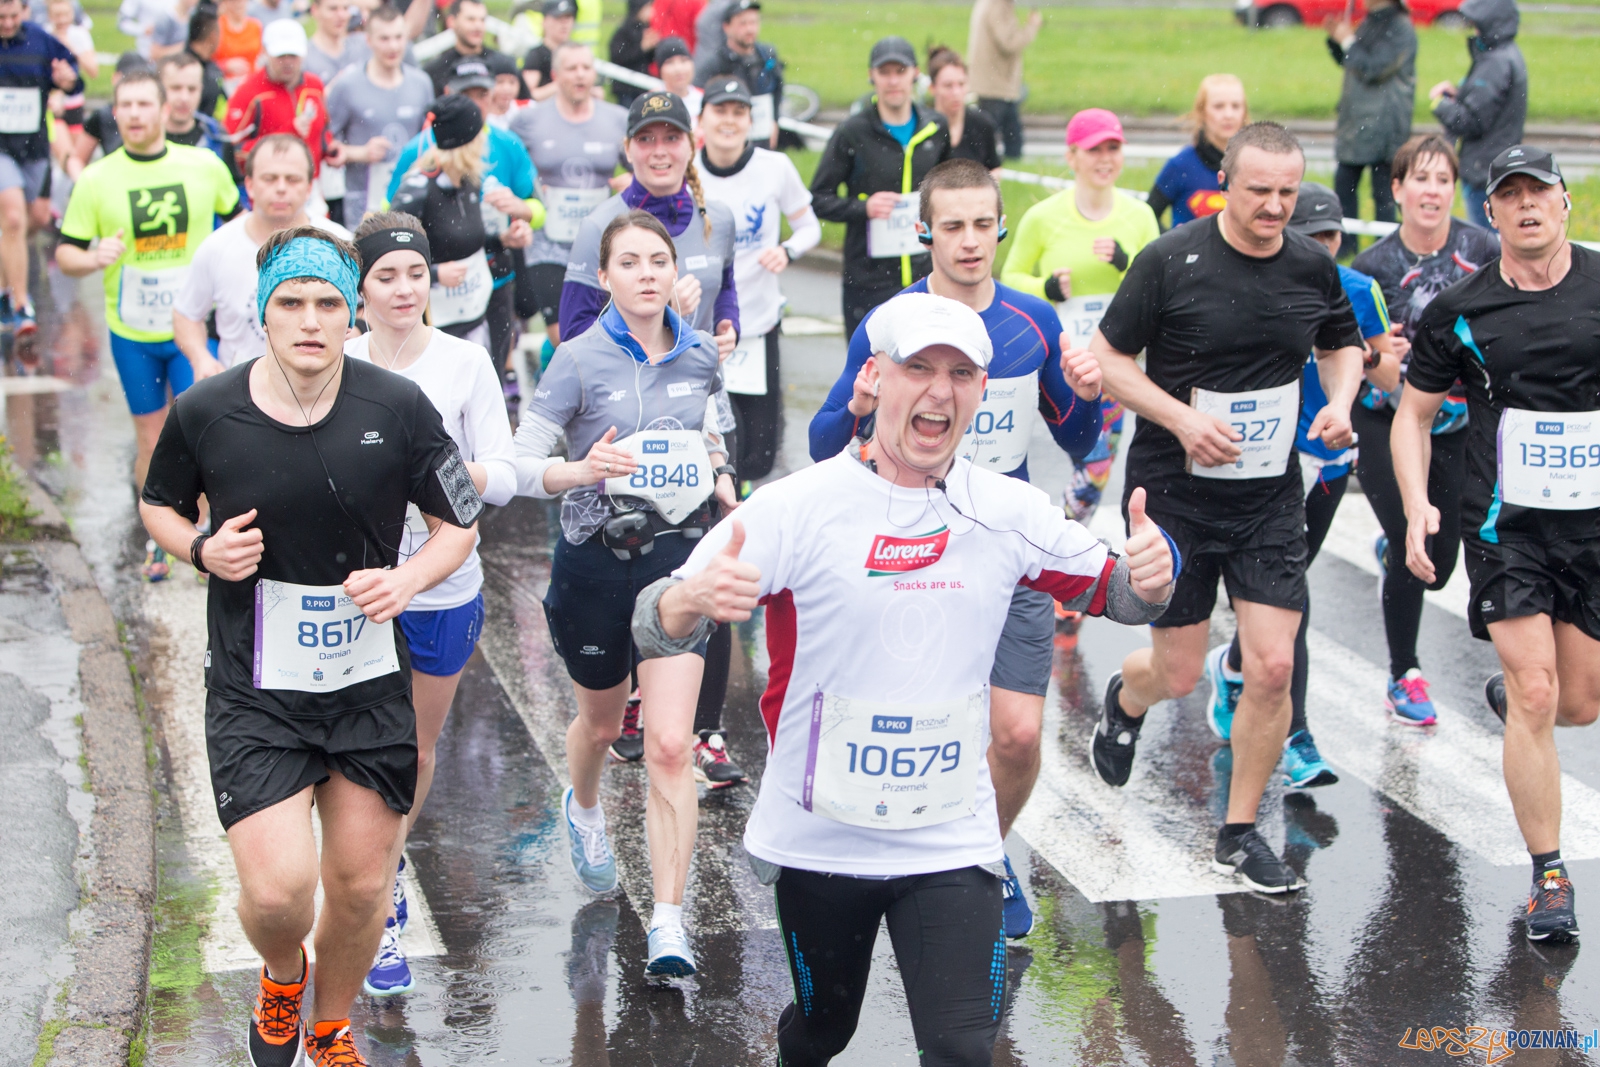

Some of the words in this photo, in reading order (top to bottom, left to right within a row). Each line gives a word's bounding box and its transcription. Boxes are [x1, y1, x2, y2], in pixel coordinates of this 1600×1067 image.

[964, 409, 1015, 435] 04
[971, 438, 997, 446] Adrian
[1520, 442, 1600, 469] 13369
[629, 463, 699, 488] 8848
[1549, 472, 1577, 481] Maciej
[874, 539, 940, 560] Lorenz
[893, 580, 927, 591] Snacks
[930, 581, 946, 590] are
[950, 580, 965, 589] us.
[298, 612, 368, 648] 8617
[319, 648, 351, 660] Damian
[846, 740, 961, 777] 10679
[881, 782, 928, 792] Przemek
